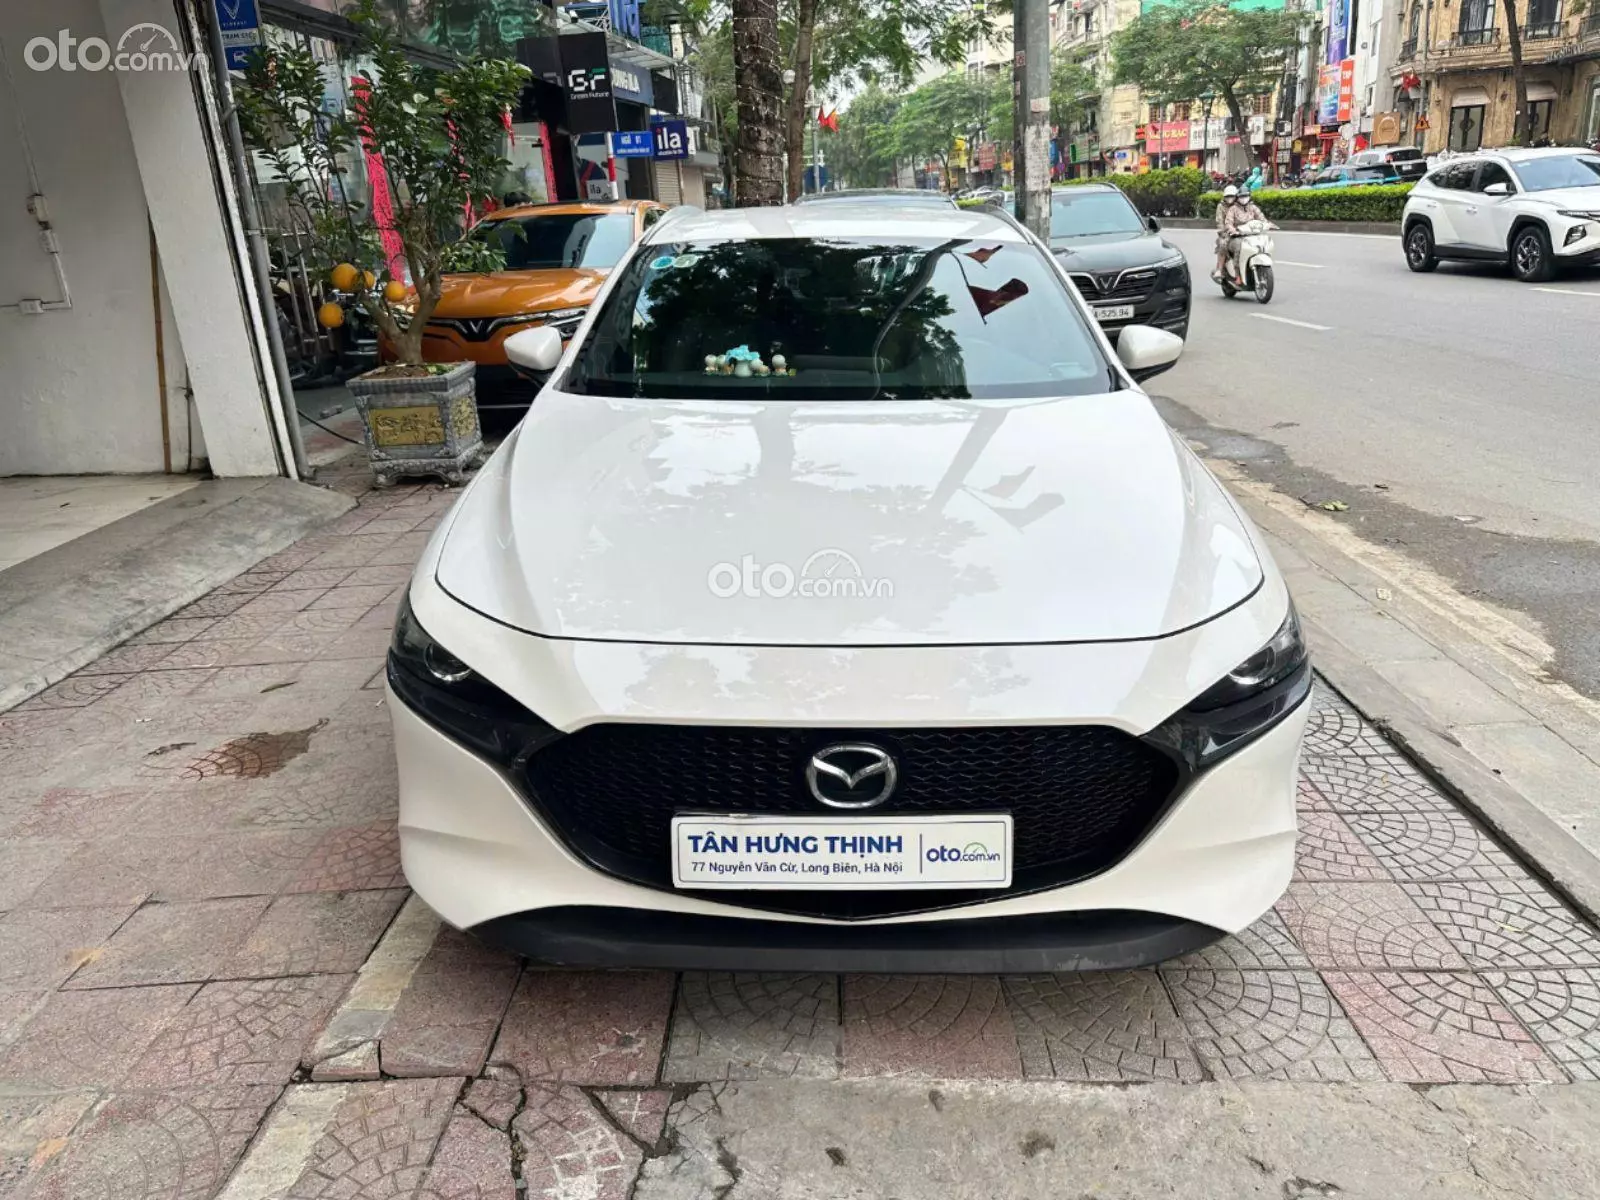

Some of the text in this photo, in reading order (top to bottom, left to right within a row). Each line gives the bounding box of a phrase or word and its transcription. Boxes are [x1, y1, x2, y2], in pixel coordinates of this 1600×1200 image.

[656, 126, 682, 150] ila
[687, 831, 903, 858] TÂN HƯNG THỊNH
[926, 845, 1001, 862] oto.com.vn
[692, 861, 705, 872] 77
[755, 861, 777, 873] Văn
[801, 862, 829, 875] Long
[832, 862, 861, 874] Biên,
[864, 862, 880, 873] Hà
[883, 861, 903, 875] Nội
